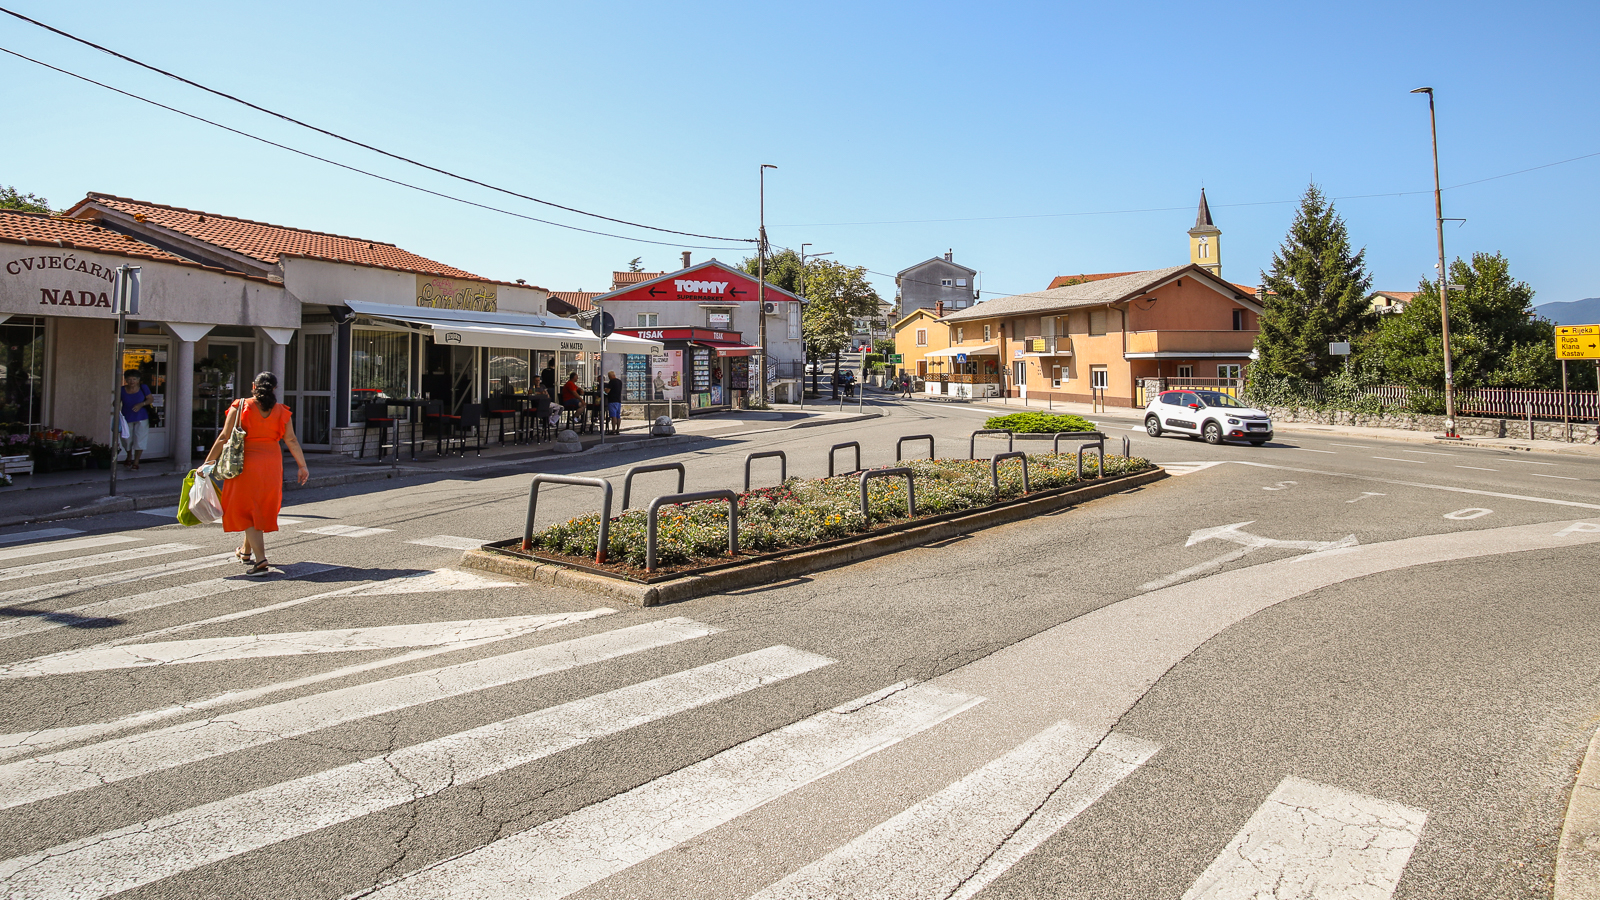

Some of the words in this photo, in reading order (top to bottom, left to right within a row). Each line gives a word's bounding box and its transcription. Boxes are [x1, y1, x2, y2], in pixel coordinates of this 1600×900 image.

[6, 254, 115, 283] CVJEĆARN
[674, 280, 729, 294] TOMMY
[40, 288, 111, 308] NADA
[637, 331, 664, 339] TISAK
[713, 332, 724, 340] TISAK
[560, 342, 569, 350] SAN
[570, 342, 584, 350] MATEO
